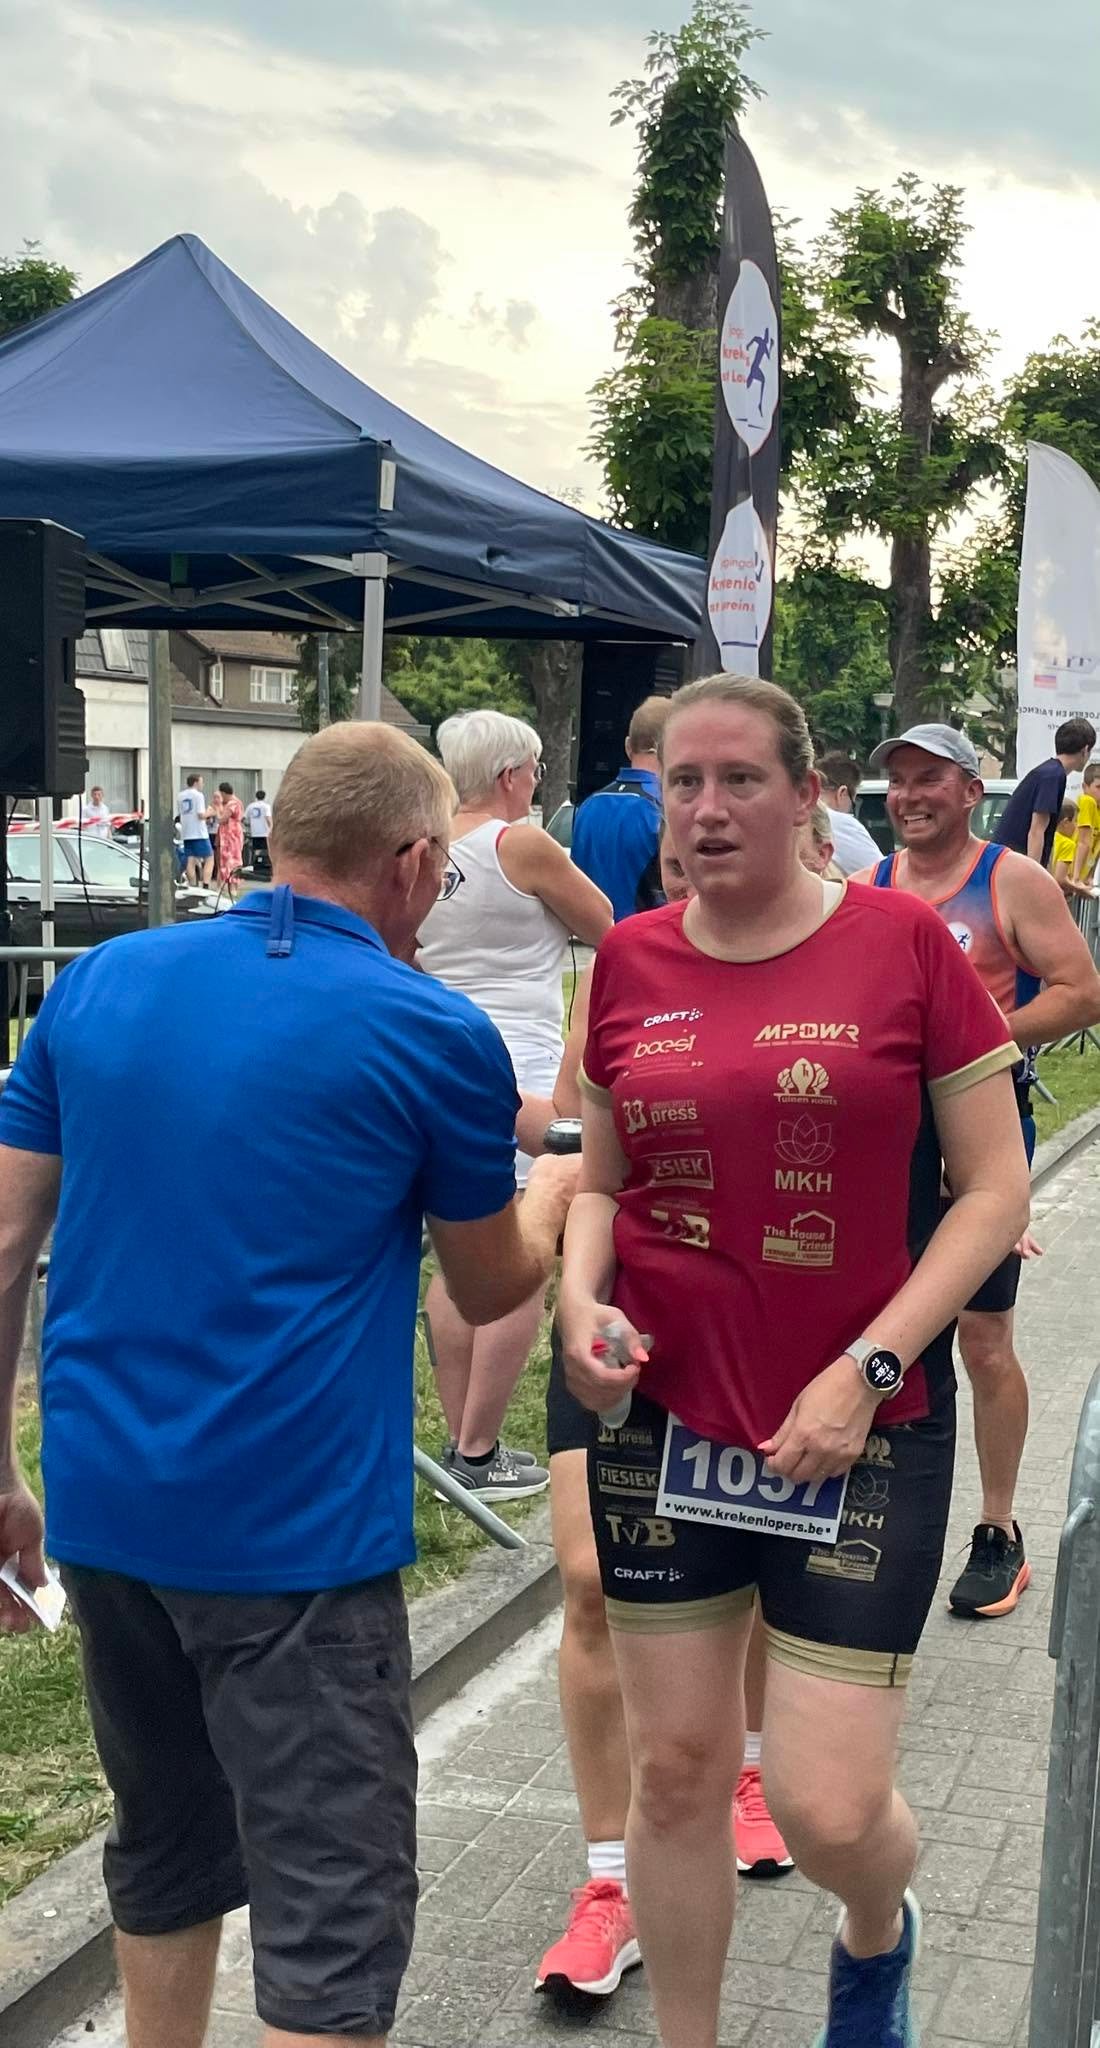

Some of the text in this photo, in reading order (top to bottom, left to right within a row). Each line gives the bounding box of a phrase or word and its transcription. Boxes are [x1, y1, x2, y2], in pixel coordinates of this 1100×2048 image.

[643, 1011, 690, 1028] CRAFT
[650, 1107, 698, 1127] press
[774, 1168, 833, 1193] MKH
[763, 1225, 826, 1241] The House
[599, 1467, 658, 1488] FIESIEK
[674, 1503, 825, 1536] www.krekenlopers.be
[842, 1510, 885, 1530] KH
[614, 1567, 666, 1581] CRAFT
